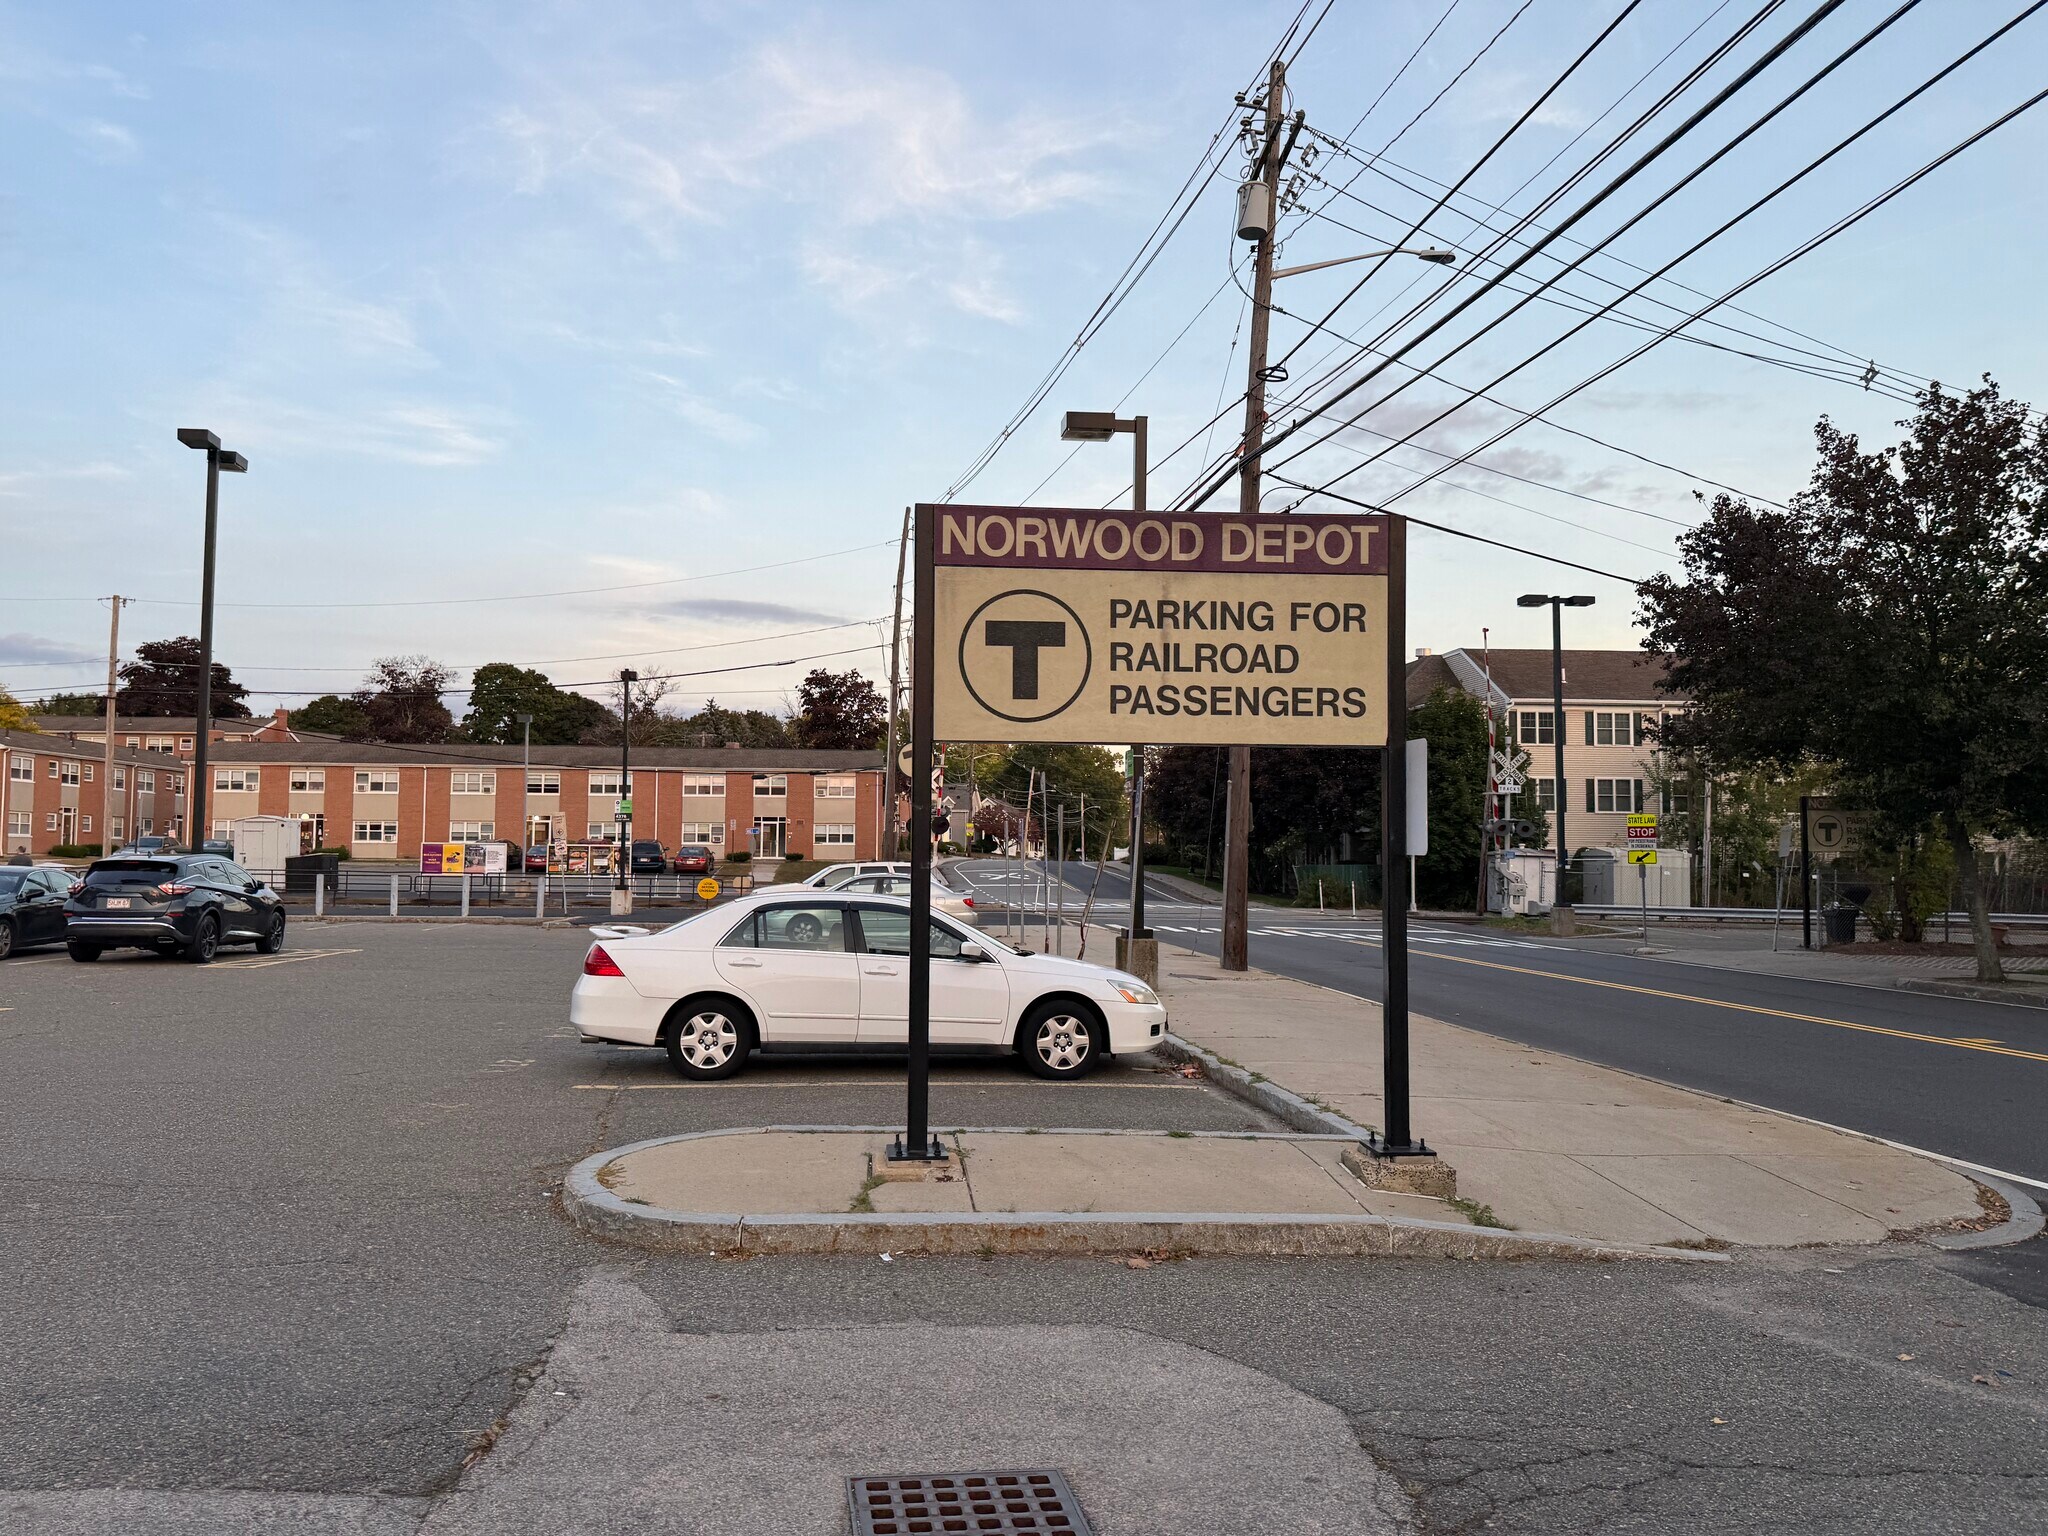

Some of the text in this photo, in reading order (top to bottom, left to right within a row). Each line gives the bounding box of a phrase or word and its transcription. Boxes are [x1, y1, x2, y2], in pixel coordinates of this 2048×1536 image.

[942, 515, 1379, 565] NORWOOD DEPOT
[1109, 598, 1366, 633] PARKING FOR
[985, 620, 1066, 700] T
[1109, 641, 1300, 674] RAILROAD
[1109, 684, 1367, 718] PASSENGERS
[1496, 753, 1524, 781] CROSSING
[1627, 816, 1655, 824] STATE LAW
[1629, 827, 1655, 837] STOP
[1818, 822, 1837, 841] T
